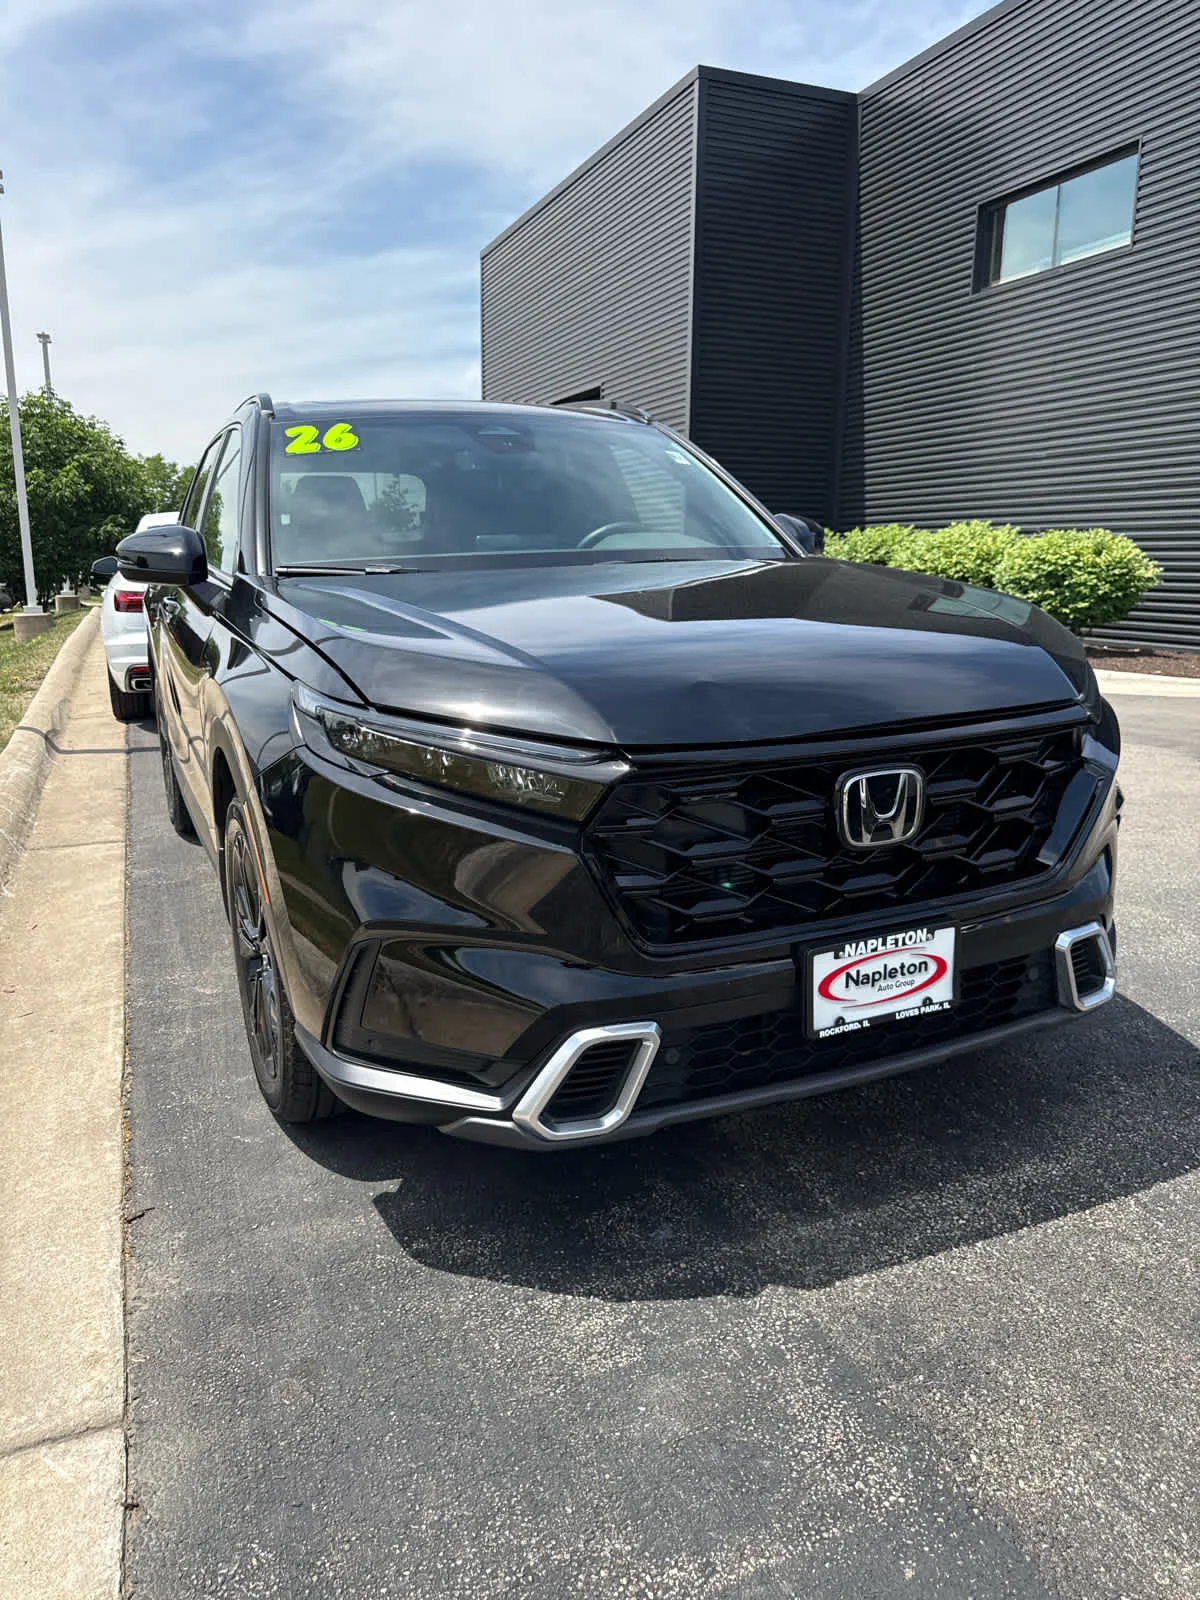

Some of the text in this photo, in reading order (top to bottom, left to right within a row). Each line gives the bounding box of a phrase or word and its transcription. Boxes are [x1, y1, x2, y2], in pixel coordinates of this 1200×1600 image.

[285, 422, 359, 454] 26
[844, 928, 928, 958] NAPLETON
[845, 960, 928, 989] Napleton
[877, 979, 915, 993] Auto Group
[895, 1007, 920, 1020] LOVES
[943, 1001, 951, 1009] IL
[862, 1019, 871, 1028] IL
